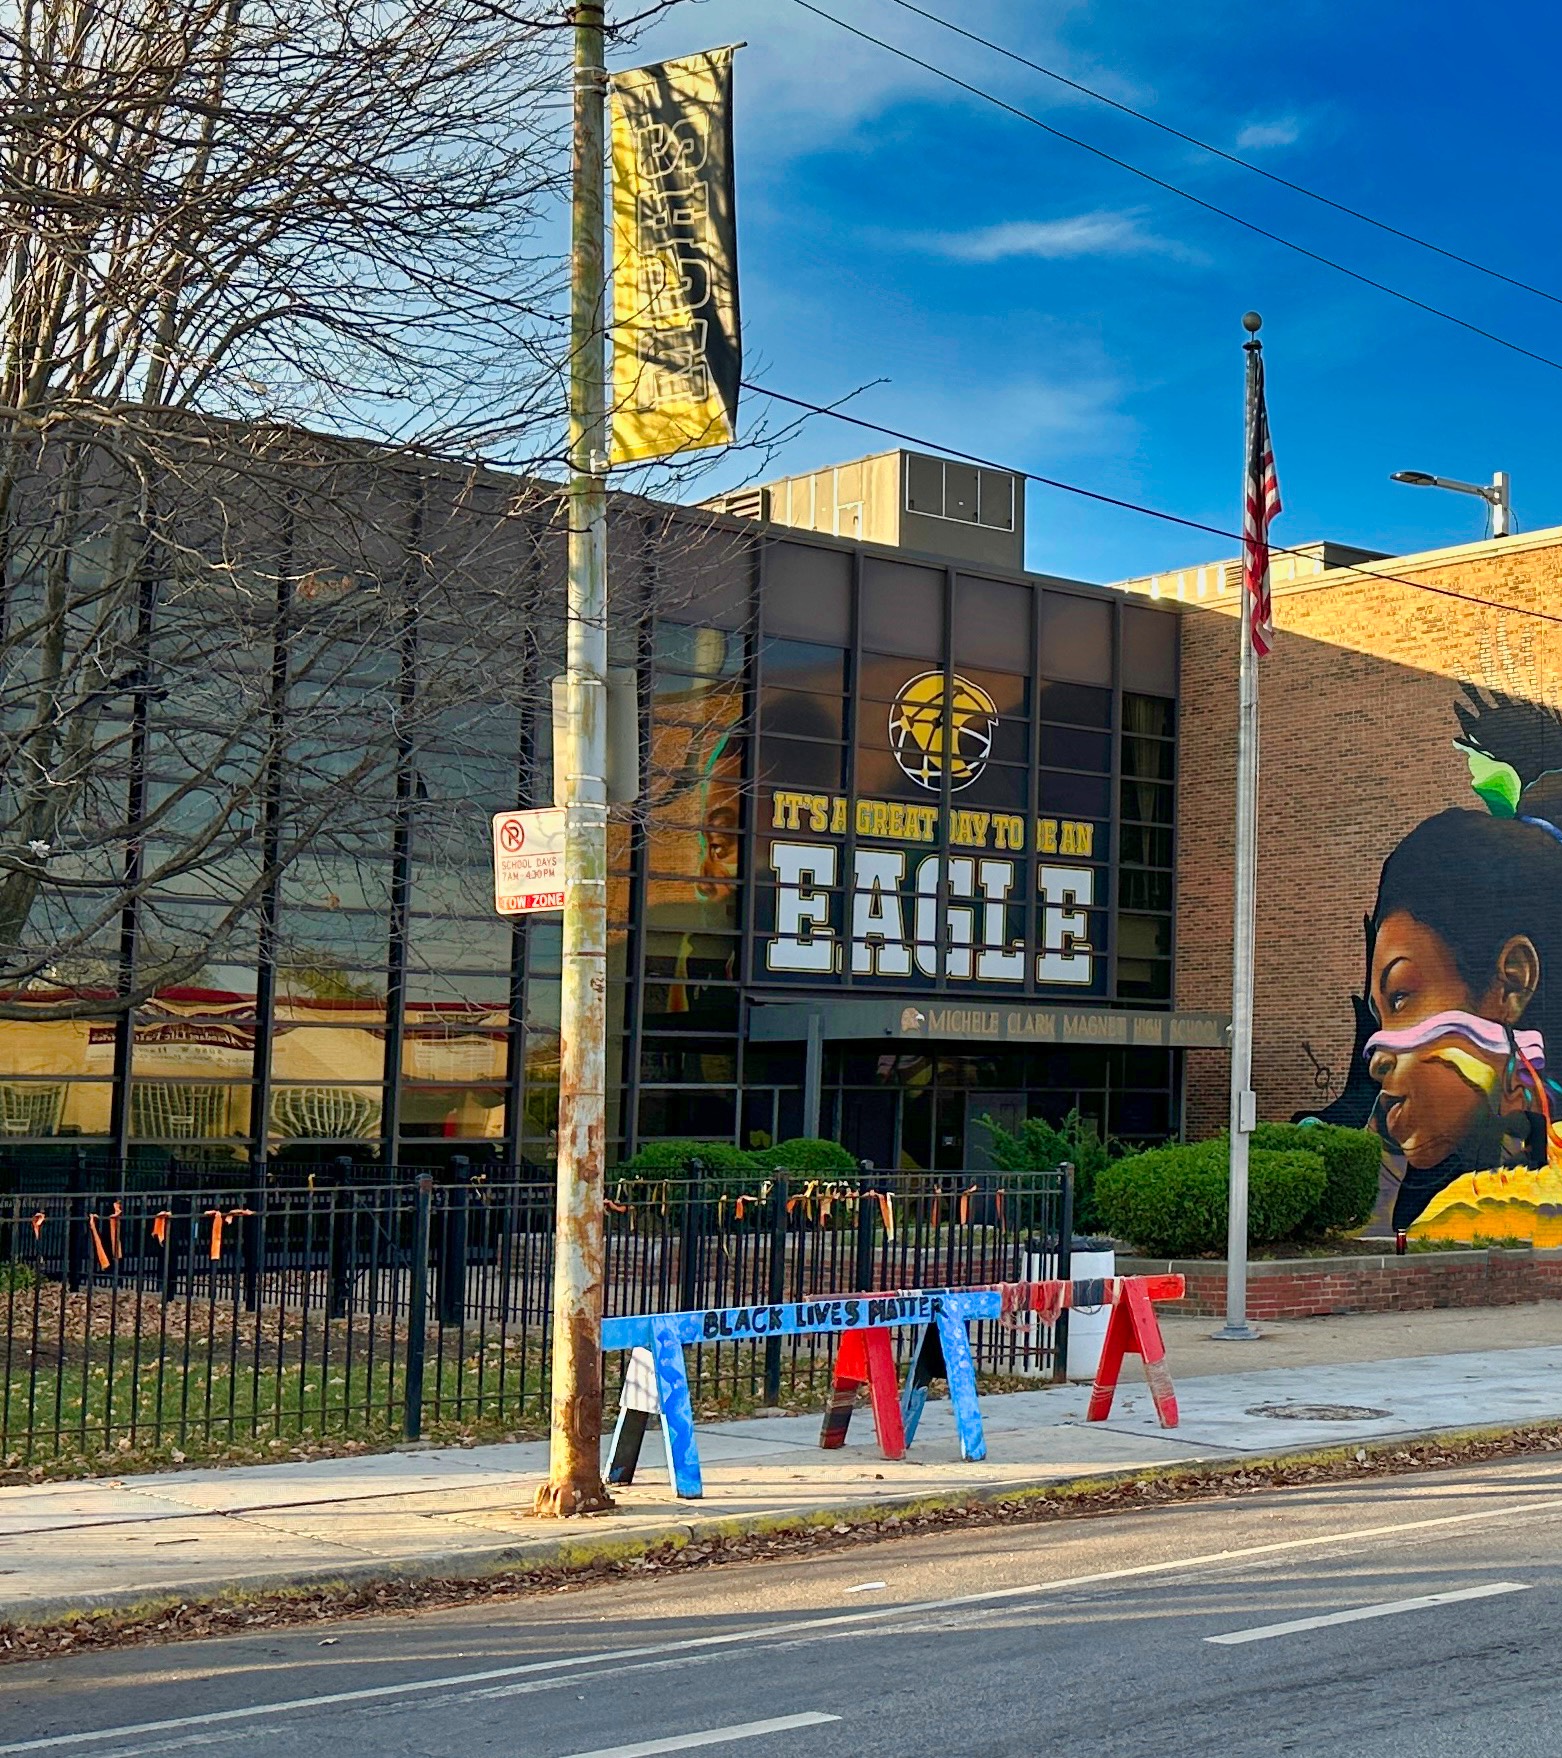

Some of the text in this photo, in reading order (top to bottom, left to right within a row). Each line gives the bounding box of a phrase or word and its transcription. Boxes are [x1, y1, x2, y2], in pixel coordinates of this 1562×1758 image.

[636, 112, 712, 411] MCHS
[772, 791, 828, 832] IT'S
[830, 797, 847, 834] A
[855, 799, 938, 841] GREAT
[991, 813, 1024, 850] TO
[1059, 820, 1094, 857] AN
[502, 856, 557, 870] SCHOOL DAYS
[502, 892, 564, 909] TOW ZONE
[766, 840, 1094, 986] EAGLE
[928, 1009, 1221, 1042] MICHELE CLARK MAGNET HIGH SCHOOL
[703, 1298, 943, 1339] BLACK LIVES MATTER
